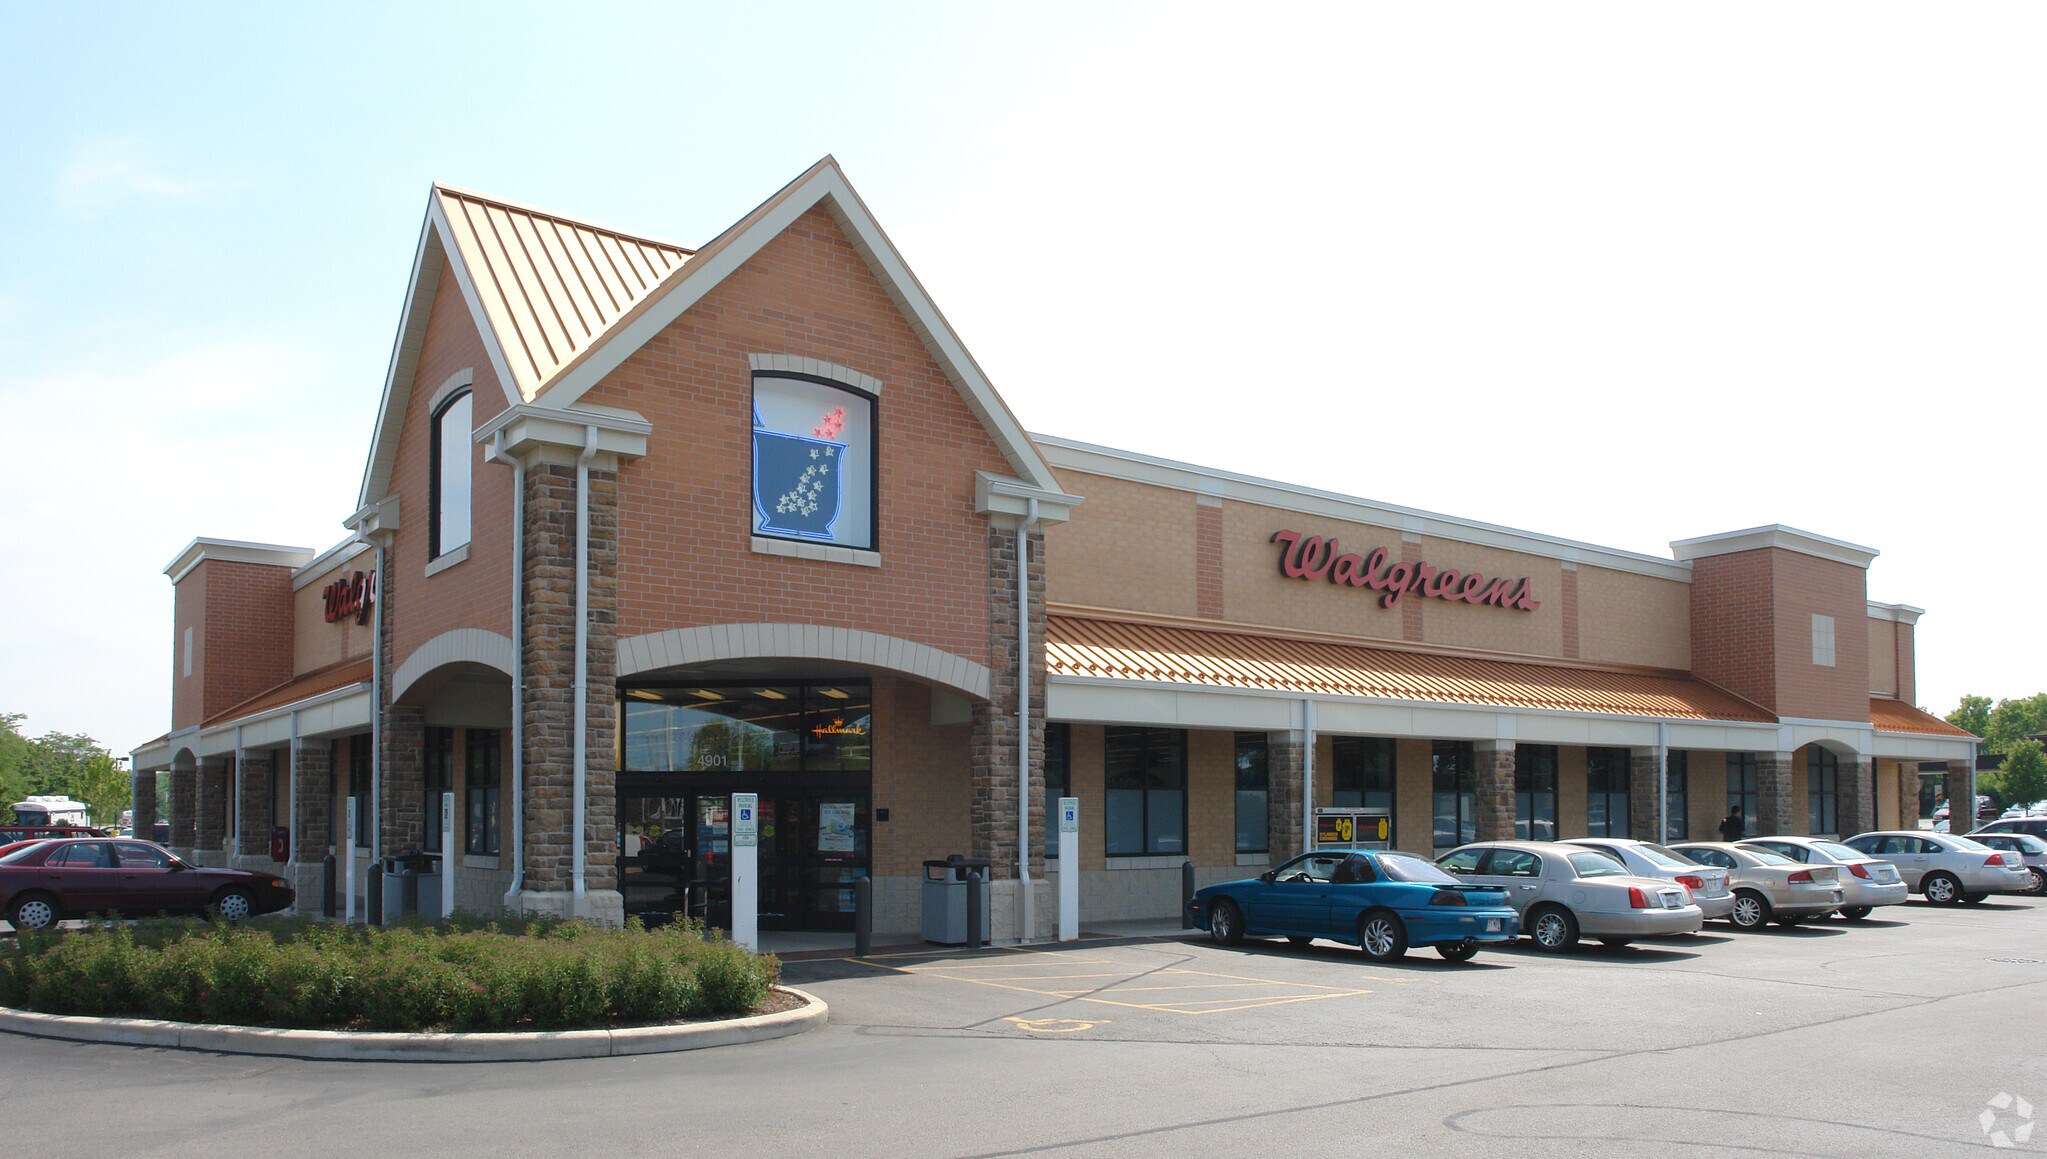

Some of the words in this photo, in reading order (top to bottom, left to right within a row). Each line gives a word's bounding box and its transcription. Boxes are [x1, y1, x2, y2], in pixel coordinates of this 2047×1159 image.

[1270, 529, 1541, 612] Walgreens
[811, 723, 867, 739] Hallmark
[697, 754, 728, 767] 4901
